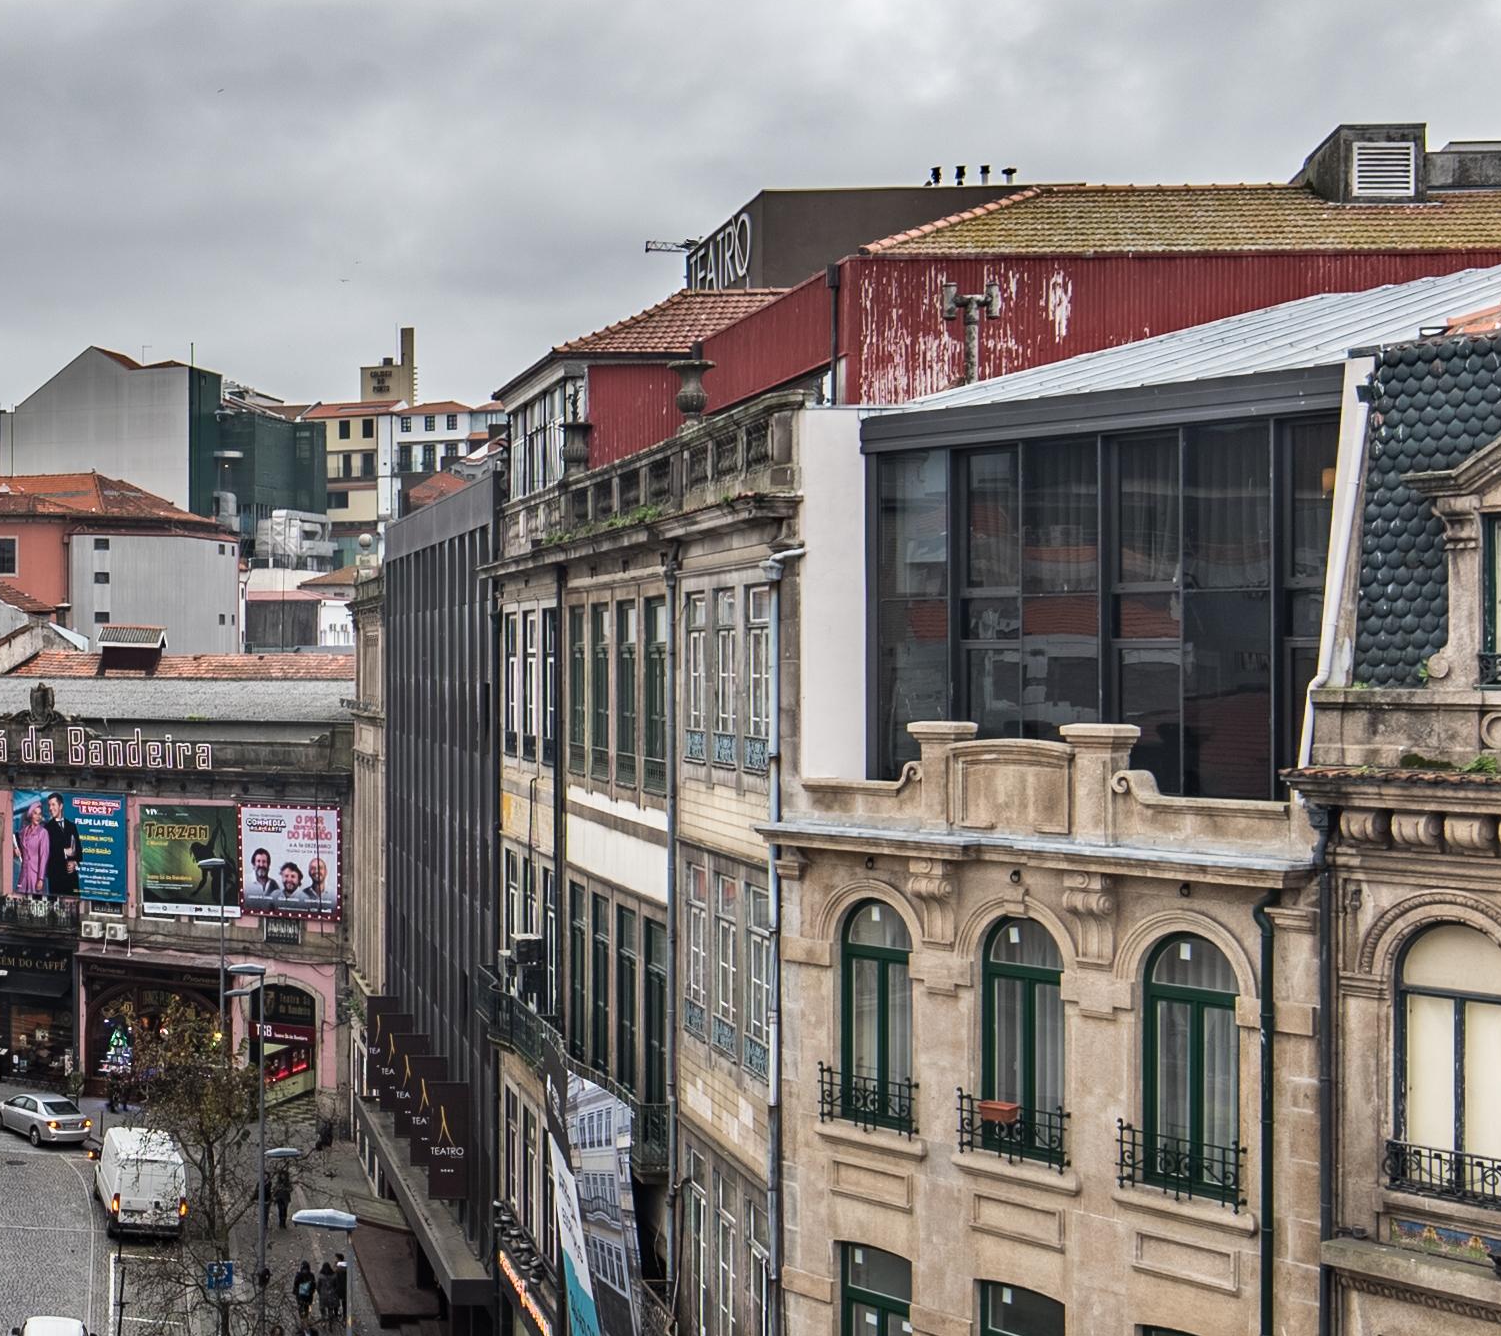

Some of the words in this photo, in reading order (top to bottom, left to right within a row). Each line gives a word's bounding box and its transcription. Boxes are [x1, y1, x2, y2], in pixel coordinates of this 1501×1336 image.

[690, 213, 752, 290] TEATRO
[21, 726, 55, 764] da
[67, 726, 212, 770] Bandeira
[144, 821, 209, 841] TARZAN
[19, 958, 32, 968] DO
[396, 1091, 411, 1099] TEA
[430, 1147, 464, 1156] TEATRO
